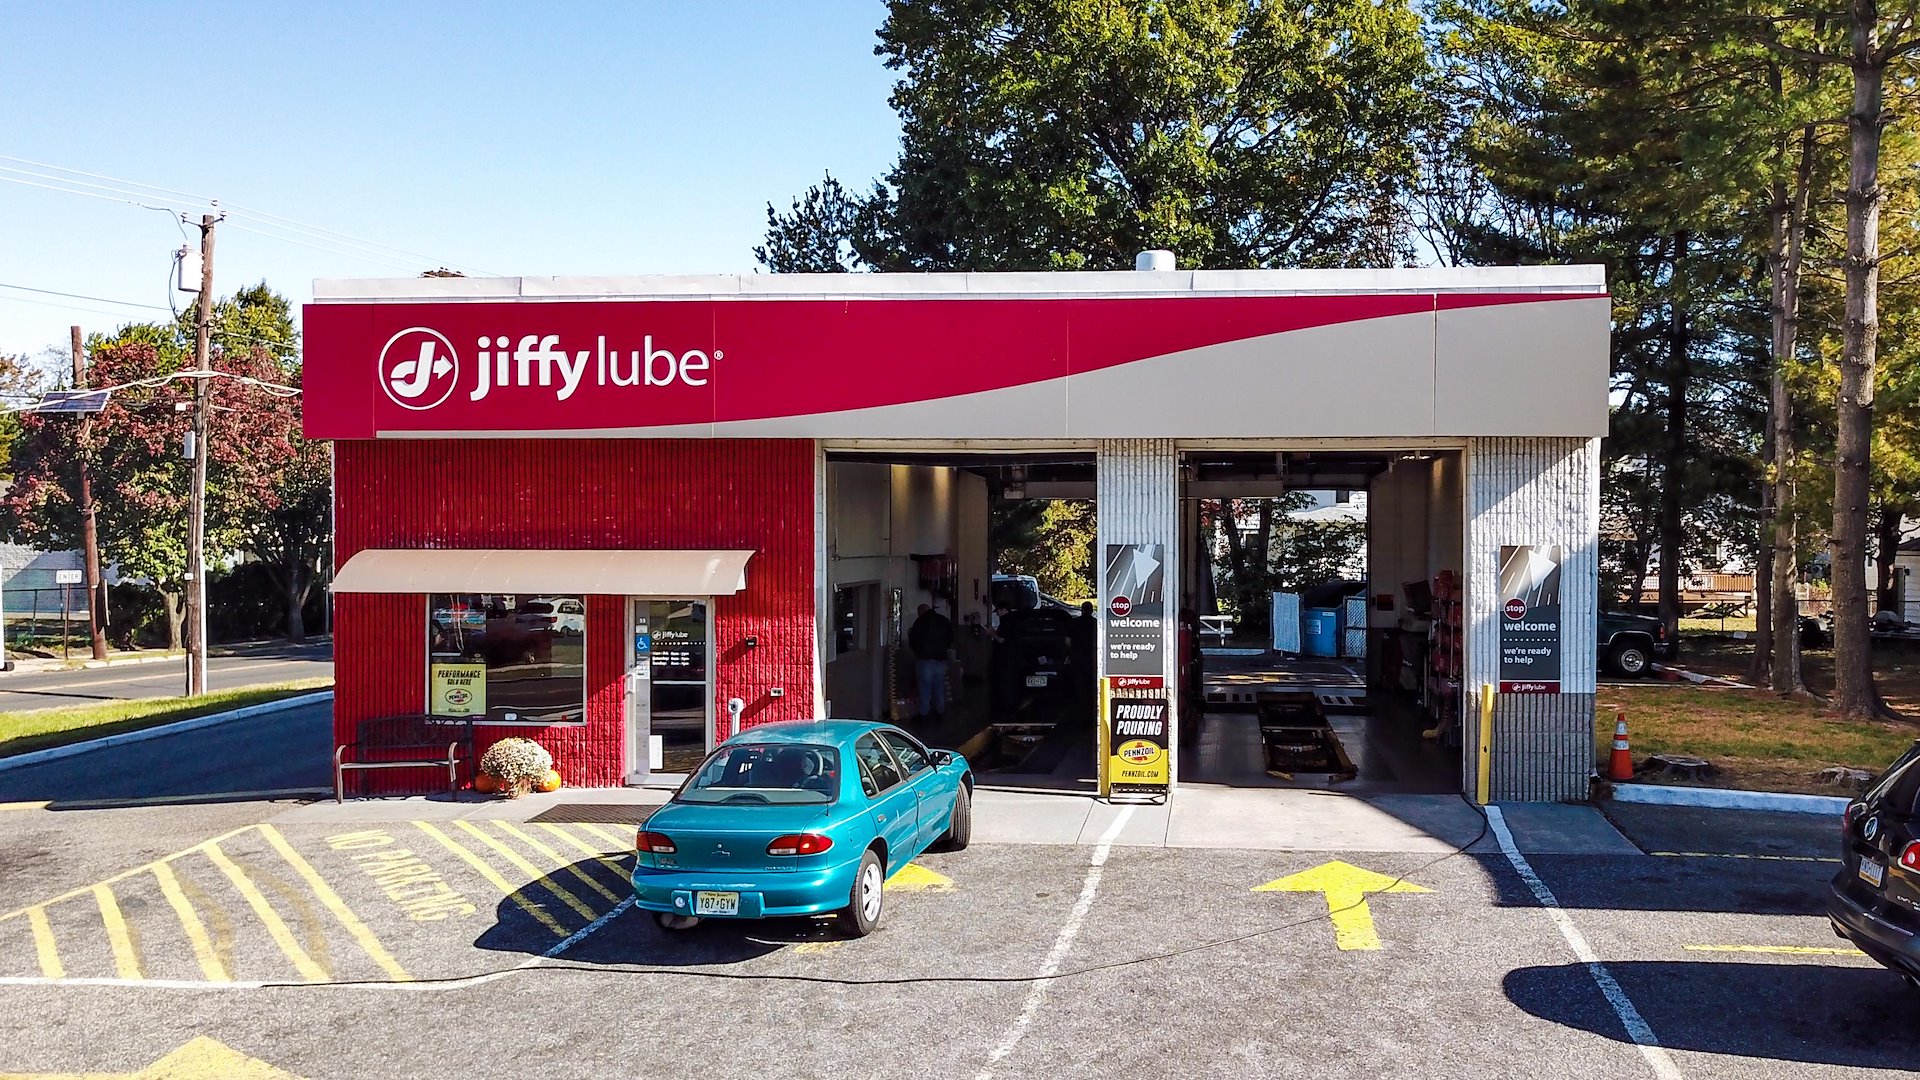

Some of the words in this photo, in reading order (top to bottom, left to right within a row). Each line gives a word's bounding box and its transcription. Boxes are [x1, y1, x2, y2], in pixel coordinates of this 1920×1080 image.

[470, 334, 590, 402] jiffy
[59, 573, 79, 581] ENTER
[1112, 602, 1130, 611] stop
[1505, 604, 1525, 613] stop
[1110, 617, 1160, 628] welcome
[1503, 620, 1557, 631] welcome
[1132, 643, 1156, 652] ready
[1503, 647, 1527, 655] we're
[1527, 646, 1552, 656] ready
[1120, 651, 1138, 660] help
[1503, 656, 1514, 664] to
[1514, 655, 1534, 665] help
[437, 670, 481, 679] PERFORMANCE
[1115, 704, 1164, 720] PROUDLY
[1116, 720, 1163, 736] POURING
[1123, 747, 1155, 757] PENNZOIL
[1121, 770, 1159, 778] PENNZOIL.COM
[324, 829, 395, 850] NO
[351, 848, 477, 921] PARKING
